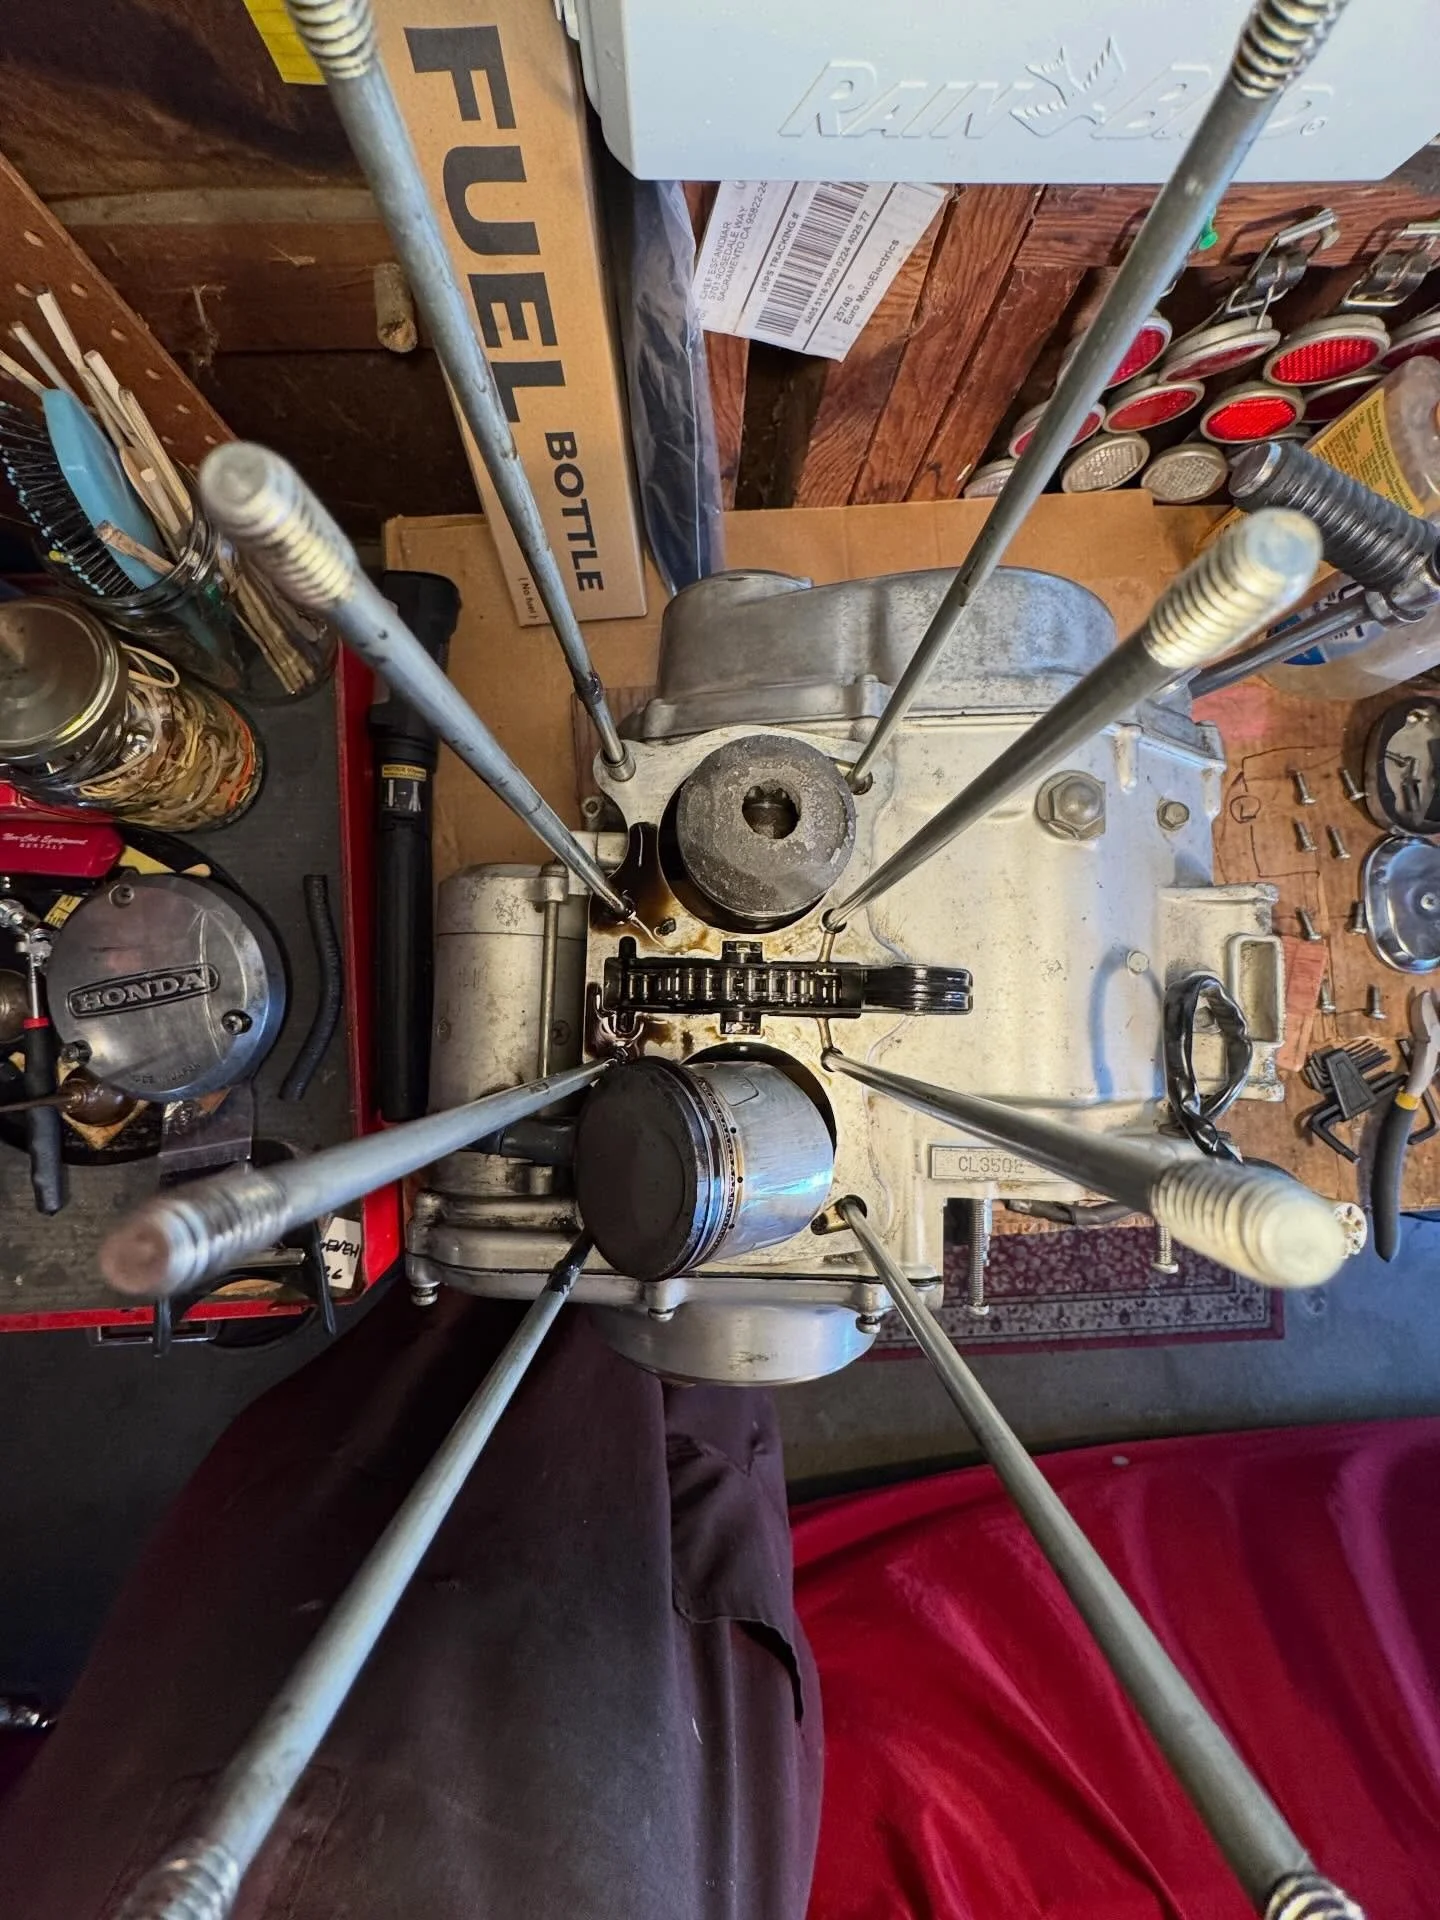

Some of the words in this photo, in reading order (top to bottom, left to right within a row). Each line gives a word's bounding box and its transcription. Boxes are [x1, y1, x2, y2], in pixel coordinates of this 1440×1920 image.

[778, 59, 1035, 138] RAIN
[1091, 62, 1334, 139] BD
[403, 25, 566, 423] FUEL
[716, 231, 739, 281] ROSEDALE
[735, 205, 748, 229] WAY
[859, 210, 870, 223] 77
[717, 241, 745, 302] SACRAMENTO
[740, 227, 751, 240] CA
[760, 270, 774, 293] USPS
[769, 220, 796, 269] TRACKING
[842, 304, 859, 325] Euro
[856, 239, 900, 302] MotoElectrics
[833, 296, 853, 322] 25740
[544, 431, 604, 591] BOTTLE
[77, 972, 207, 1012] HONDA
